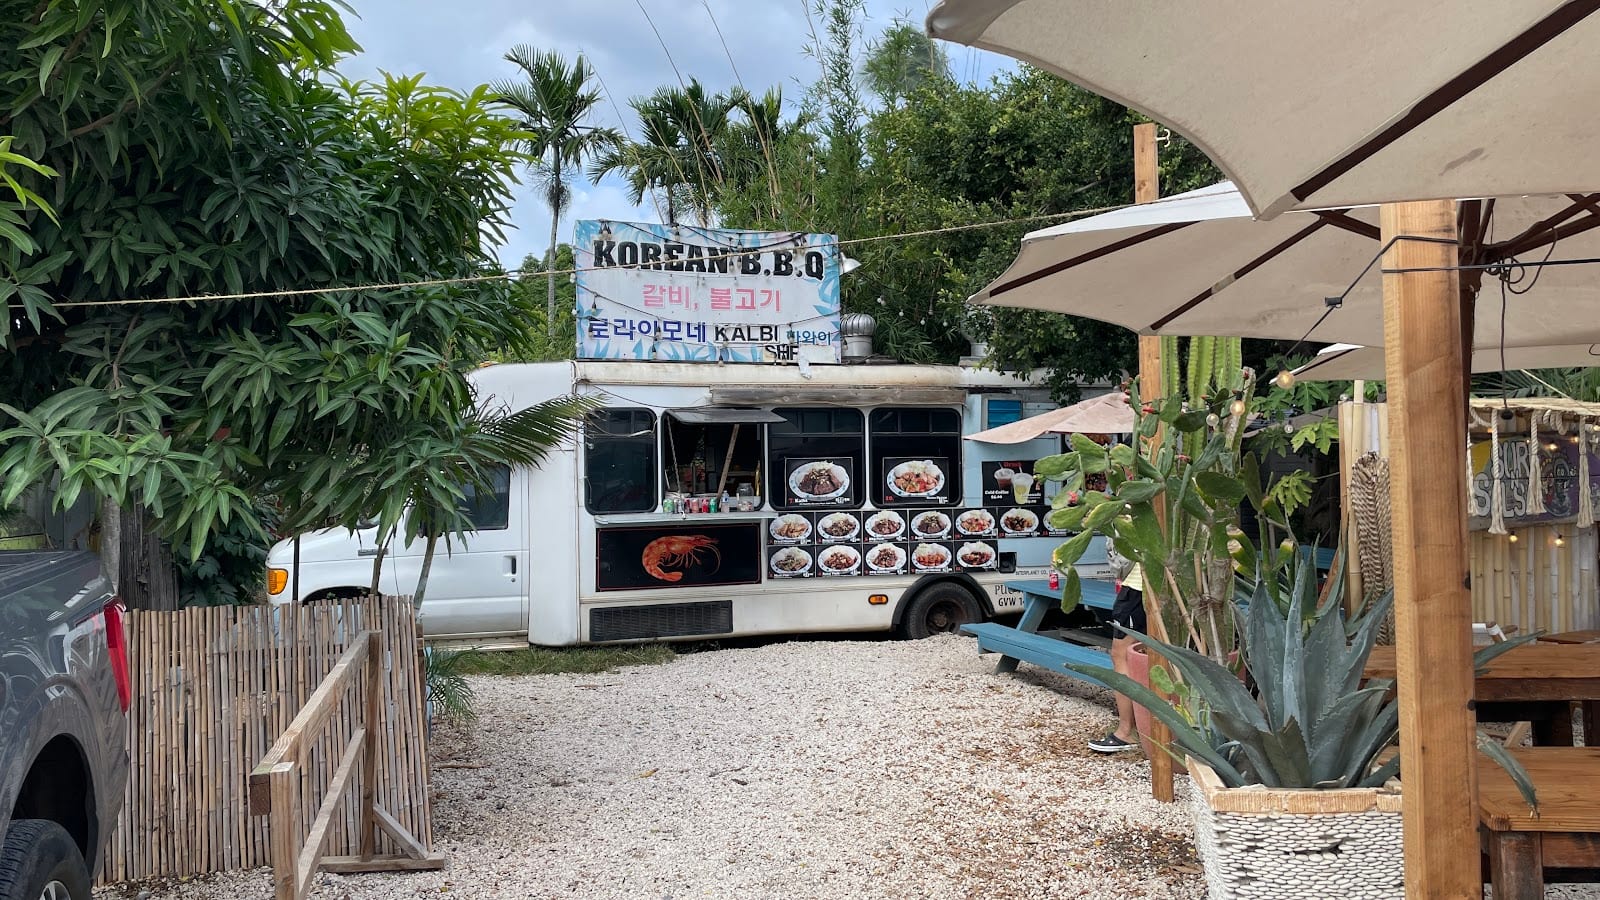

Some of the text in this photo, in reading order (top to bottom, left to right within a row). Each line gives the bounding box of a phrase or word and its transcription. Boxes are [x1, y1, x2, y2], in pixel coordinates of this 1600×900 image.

[593, 240, 824, 281] KOREAN B.B.Q
[642, 284, 781, 313] 갈비, 불고기
[715, 324, 778, 342] KALBI
[998, 597, 1016, 607] GVW
